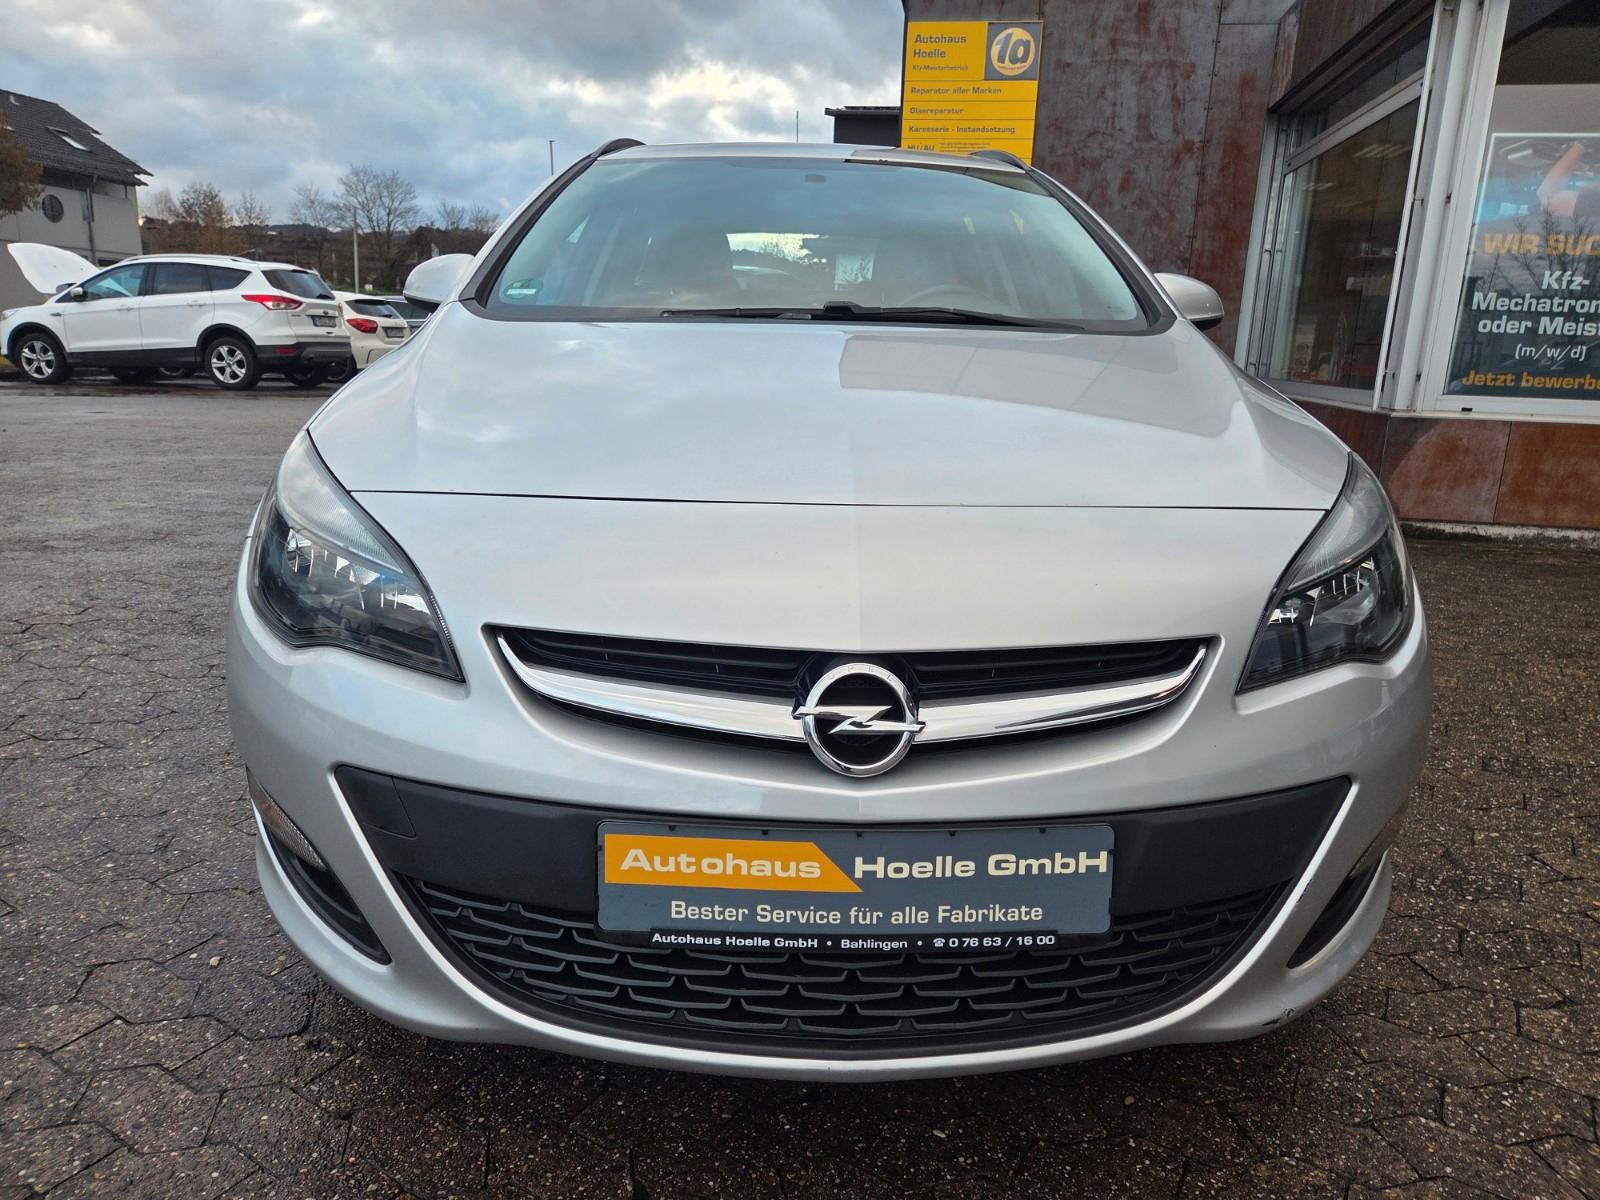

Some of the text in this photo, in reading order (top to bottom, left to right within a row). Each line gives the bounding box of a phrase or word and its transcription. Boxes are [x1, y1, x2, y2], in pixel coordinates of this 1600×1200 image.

[914, 34, 967, 44] Autohaus
[995, 32, 1031, 64] 1a
[912, 48, 946, 58] Hoelle
[911, 87, 950, 95] Reparatur
[909, 107, 964, 115] Glasreparatur
[956, 126, 1016, 134] Instandsetzung
[1483, 233, 1541, 256] WIR
[1541, 270, 1591, 290] Kfz-
[1477, 315, 1600, 336] oder Meis
[1514, 343, 1588, 361] (m/w/d)
[1462, 369, 1516, 387] Jetzt
[620, 848, 1108, 879] Autohaus Hoelle GmbH
[670, 900, 1043, 925] Bester Service für alle Fabrikate
[652, 932, 722, 946] Autohaus
[725, 936, 771, 947] Hoelle
[774, 938, 818, 949] GmbH
[840, 938, 908, 950] Bahlingen
